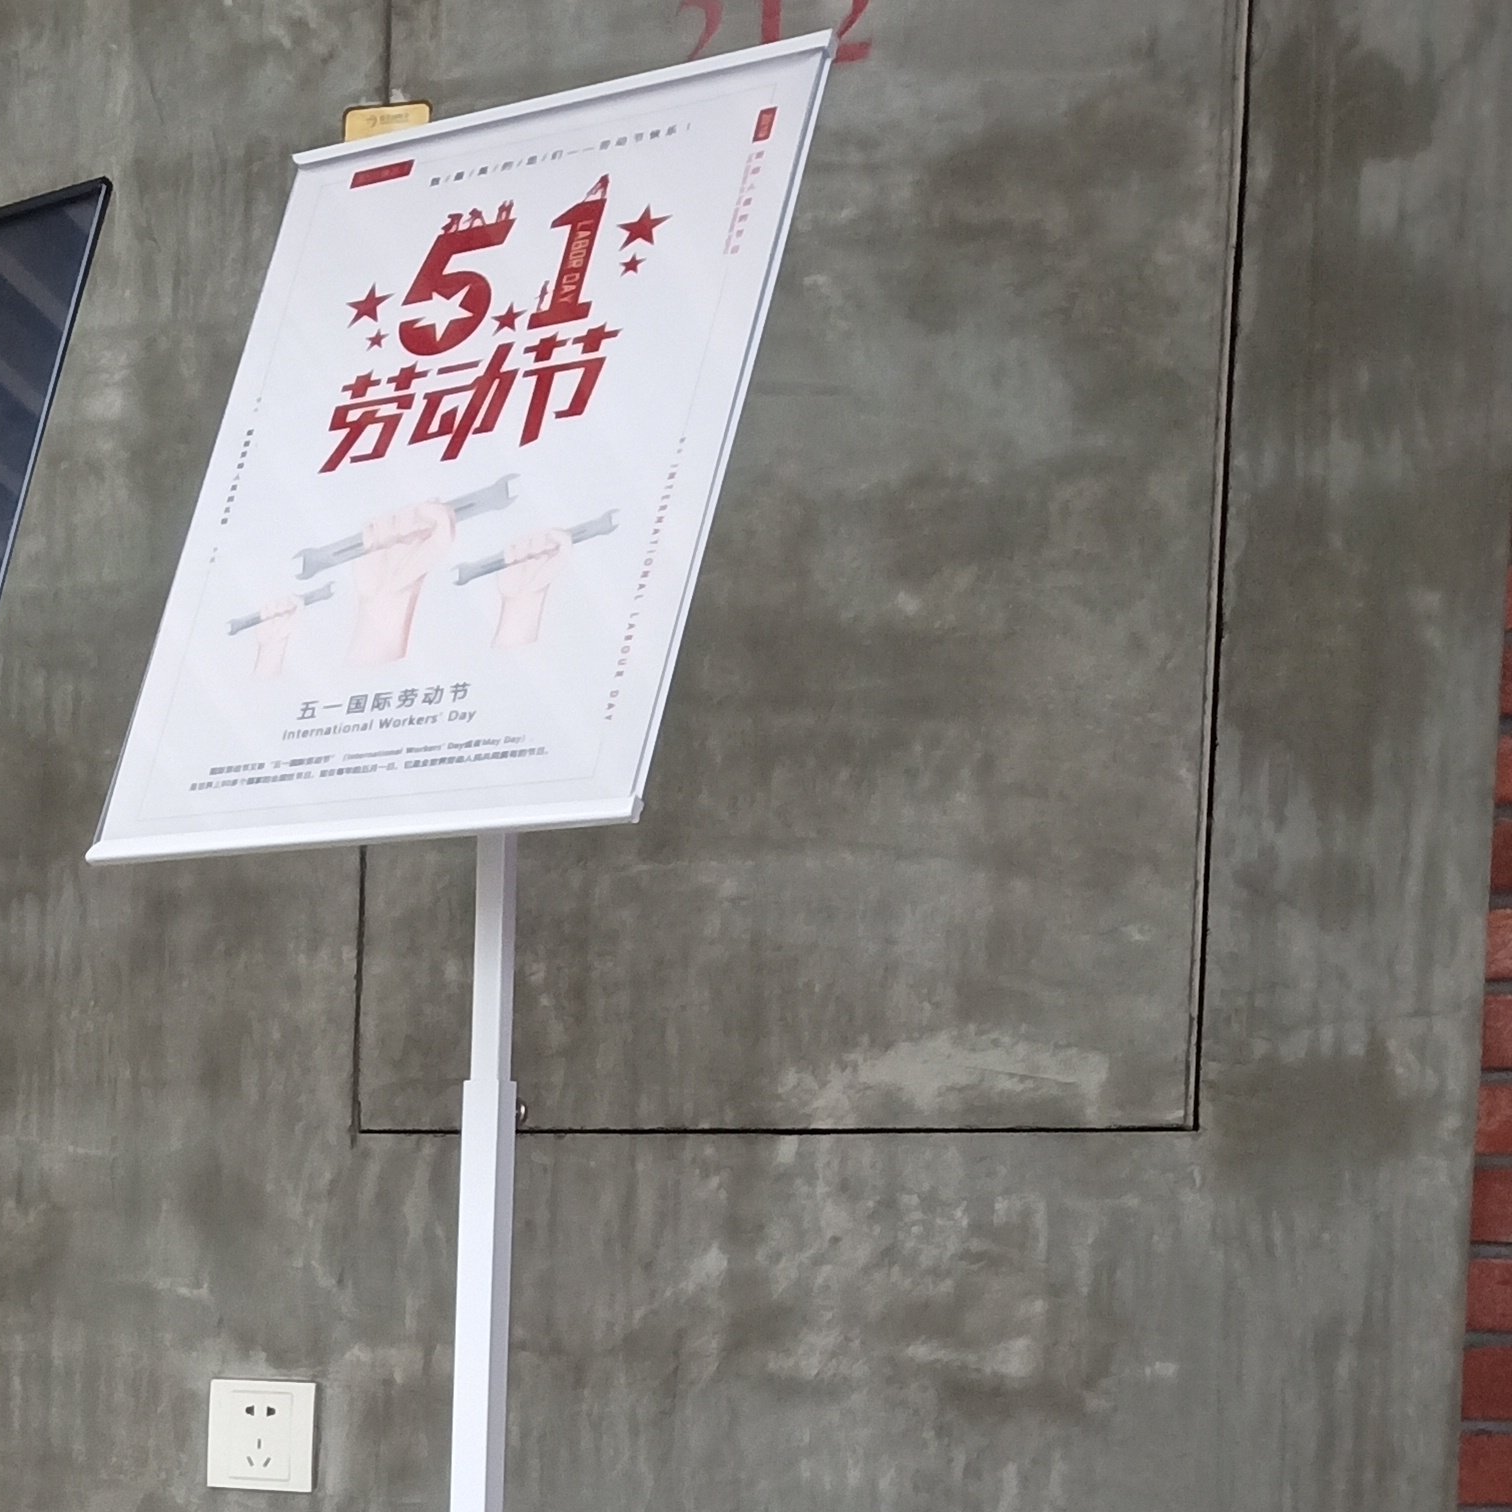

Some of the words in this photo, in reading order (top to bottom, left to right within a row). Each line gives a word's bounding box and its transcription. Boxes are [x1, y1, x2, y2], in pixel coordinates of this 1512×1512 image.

[567, 219, 595, 270] LABOR
[559, 272, 580, 303] DAY
[318, 322, 624, 474] 劳动节
[296, 681, 472, 721] 五一国际劳动节
[282, 719, 374, 741] International
[447, 709, 477, 723] Day
